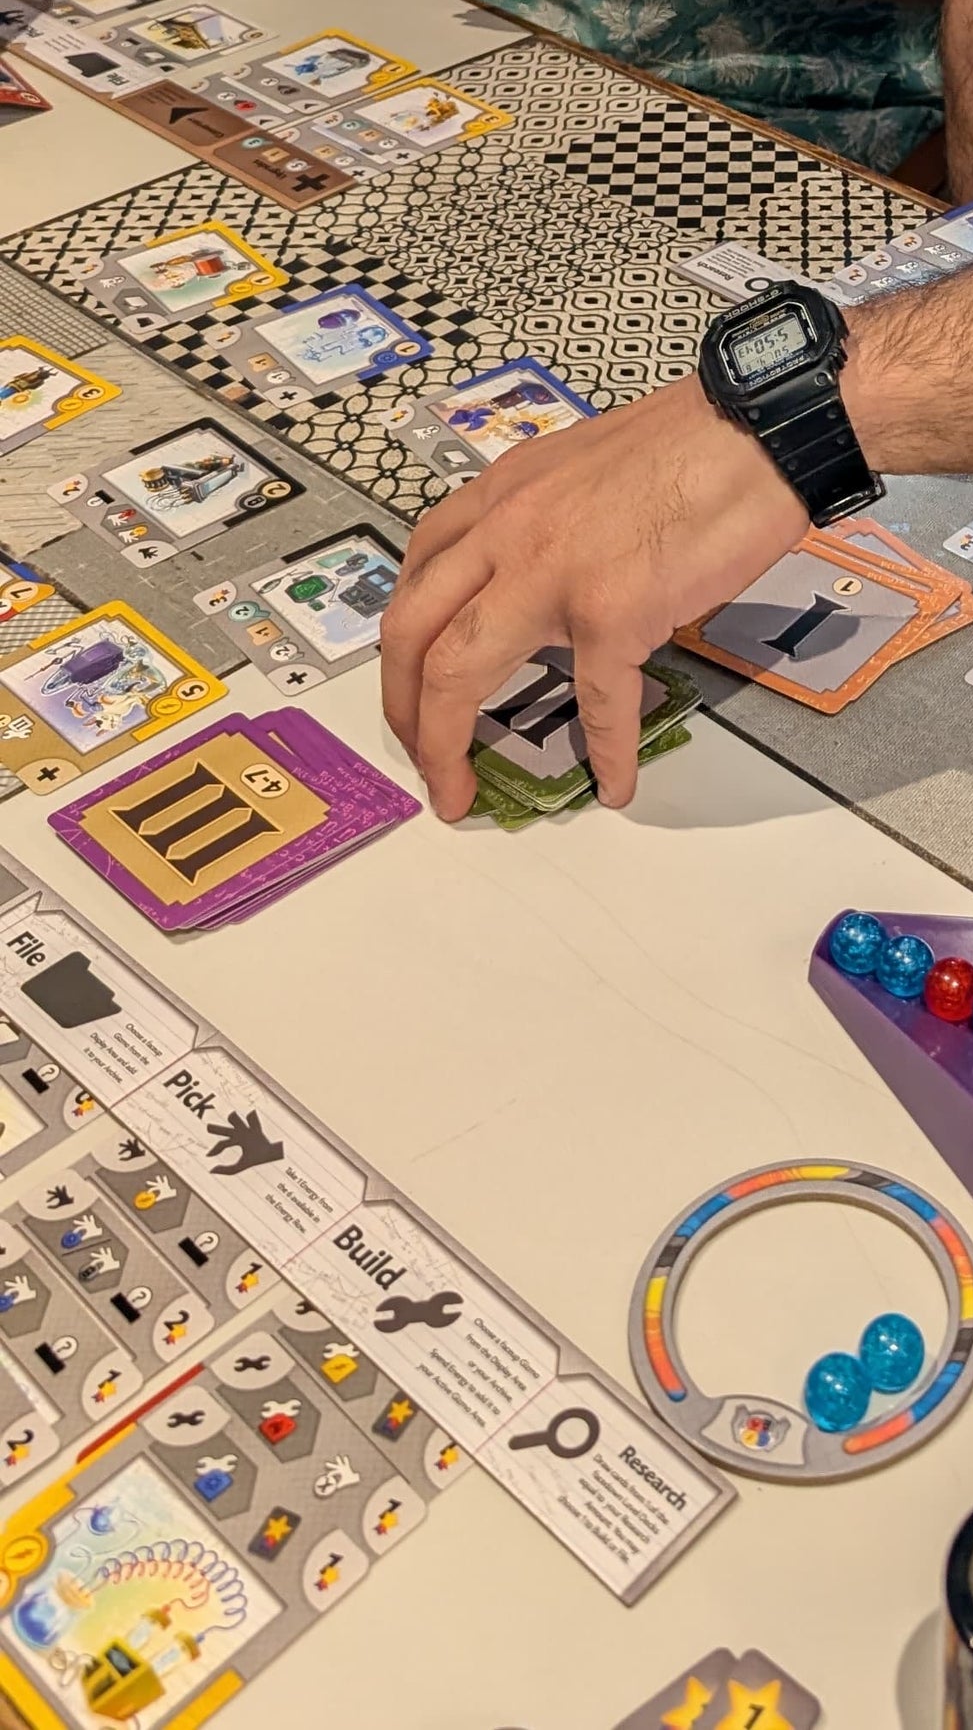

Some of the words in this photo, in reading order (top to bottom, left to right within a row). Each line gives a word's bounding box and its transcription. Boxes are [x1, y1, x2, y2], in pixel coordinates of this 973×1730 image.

[723, 289, 779, 321] G-SHOCK
[840, 580, 855, 592] 1
[181, 683, 204, 698] 5
[244, 768, 283, 794] 4-7
[109, 760, 284, 886] III
[6, 931, 46, 967] File
[125, 1023, 144, 1041] Choose
[89, 1032, 107, 1050] Display
[105, 1046, 119, 1059] Area
[115, 1055, 129, 1067] and
[89, 1054, 106, 1067] your
[127, 1045, 142, 1059] from
[139, 1055, 150, 1066] the
[163, 1069, 216, 1119] Pick
[276, 1182, 288, 1194] the
[299, 1179, 319, 1201] Energy
[317, 1197, 334, 1213] from
[264, 1193, 276, 1205] the
[273, 1201, 294, 1224] Energy
[333, 1223, 408, 1291] Build
[465, 1333, 482, 1350] from
[473, 1317, 497, 1340] Choose
[446, 1364, 469, 1388] Energy
[618, 1445, 688, 1511] Research
[743, 1703, 765, 1730] 1
